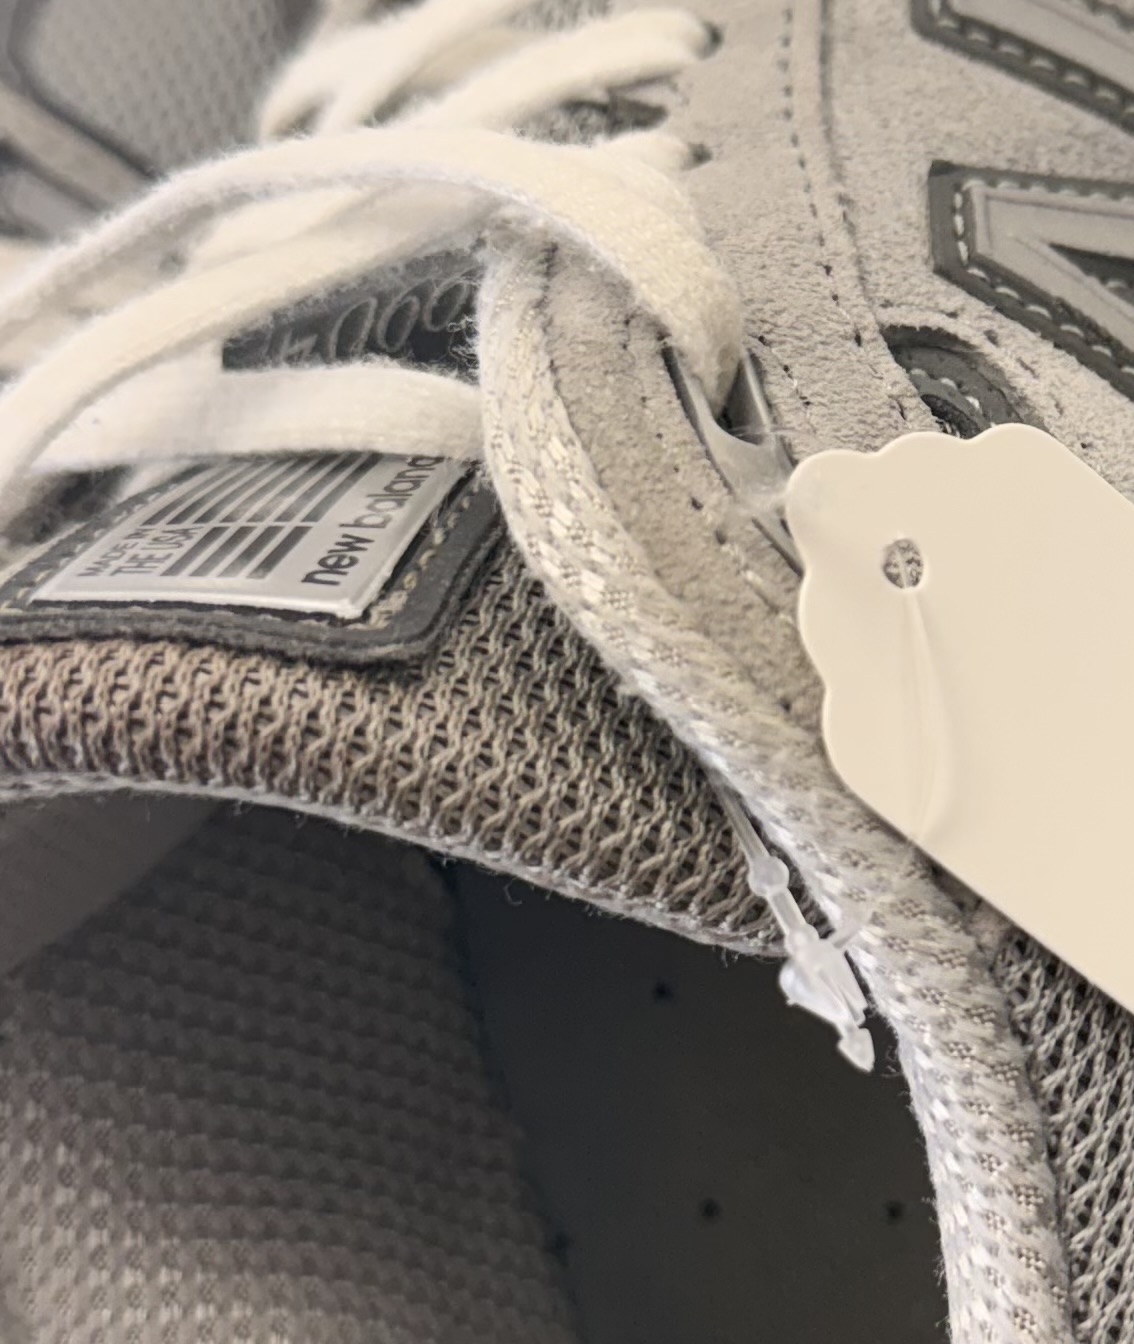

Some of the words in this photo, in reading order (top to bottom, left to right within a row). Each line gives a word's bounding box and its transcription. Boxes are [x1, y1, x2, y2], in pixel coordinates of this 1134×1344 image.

[301, 533, 375, 587] new
[339, 456, 445, 529] balanc
[140, 526, 204, 550] USA
[76, 542, 140, 576] MADE
[109, 553, 174, 576] THE
